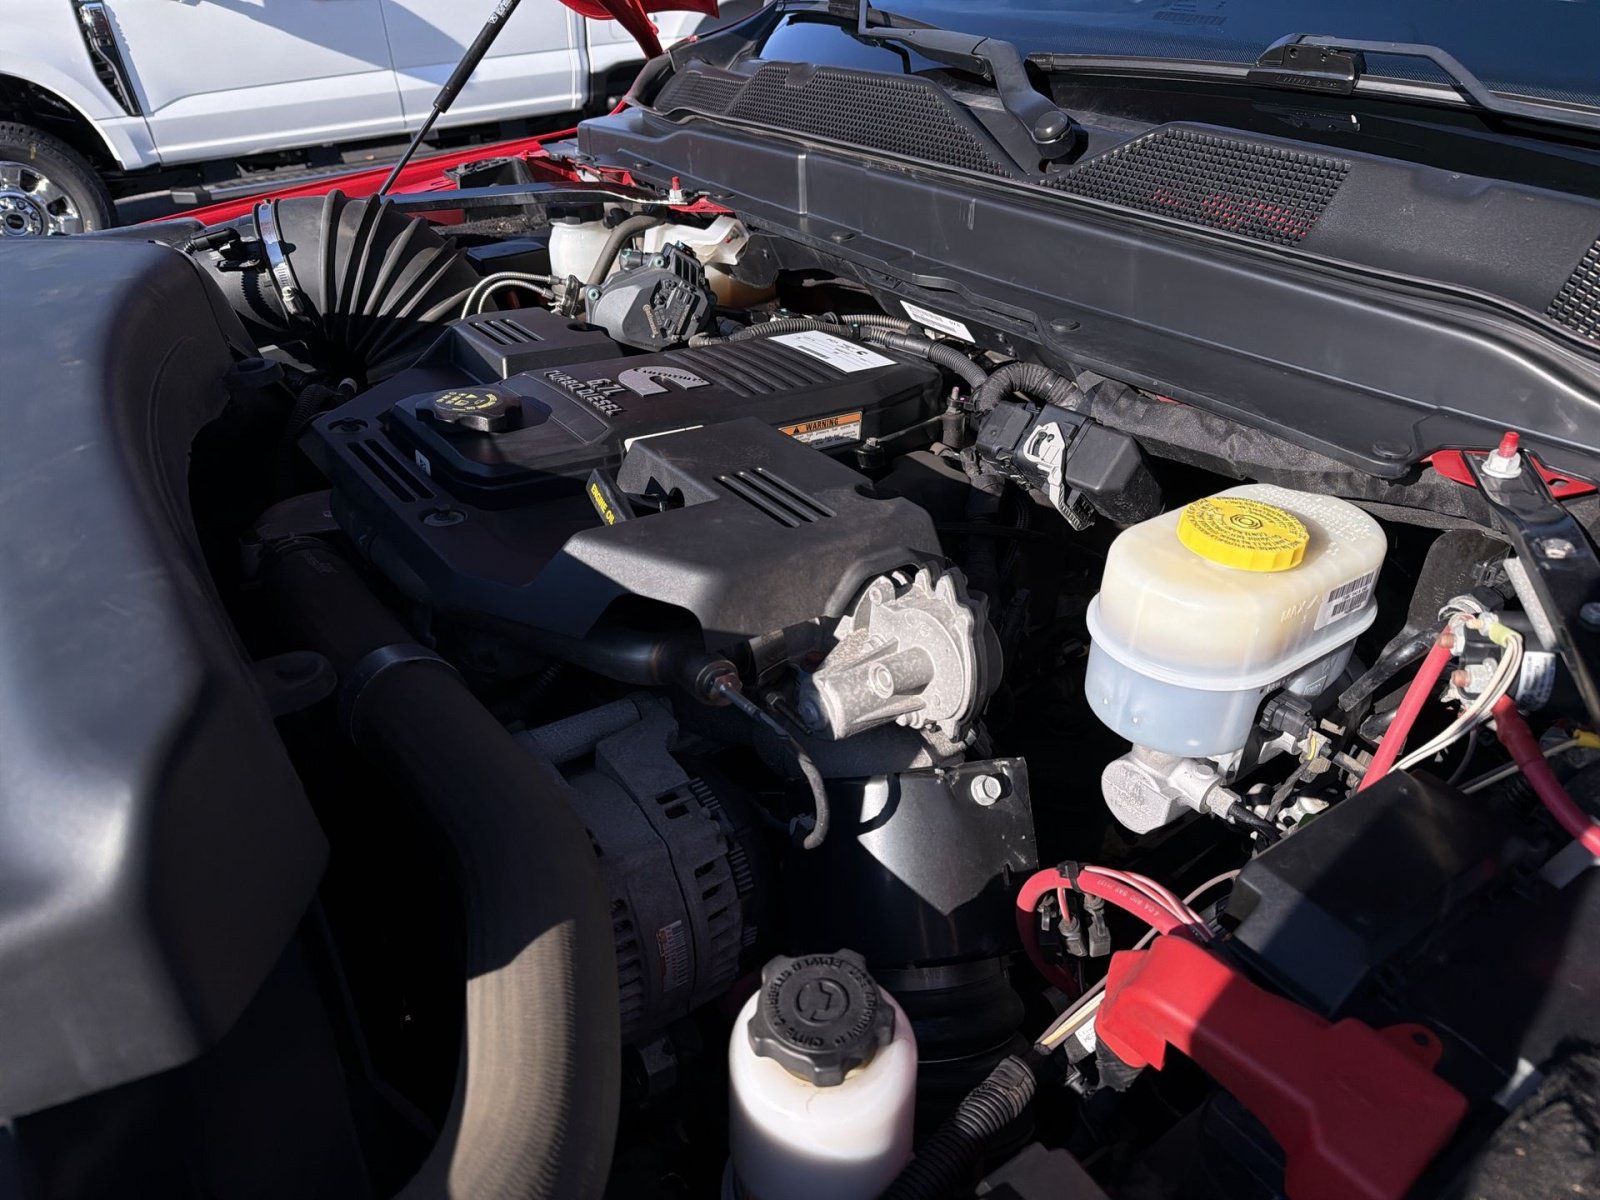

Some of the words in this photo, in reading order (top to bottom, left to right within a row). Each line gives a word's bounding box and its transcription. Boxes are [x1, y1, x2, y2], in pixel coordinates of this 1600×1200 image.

[544, 370, 585, 393] TURBO
[576, 388, 622, 417] DIESEL
[805, 418, 838, 431] WARNING
[590, 483, 608, 513] ENGINE
[606, 510, 615, 526] OIL
[1280, 600, 1306, 622] MAX
